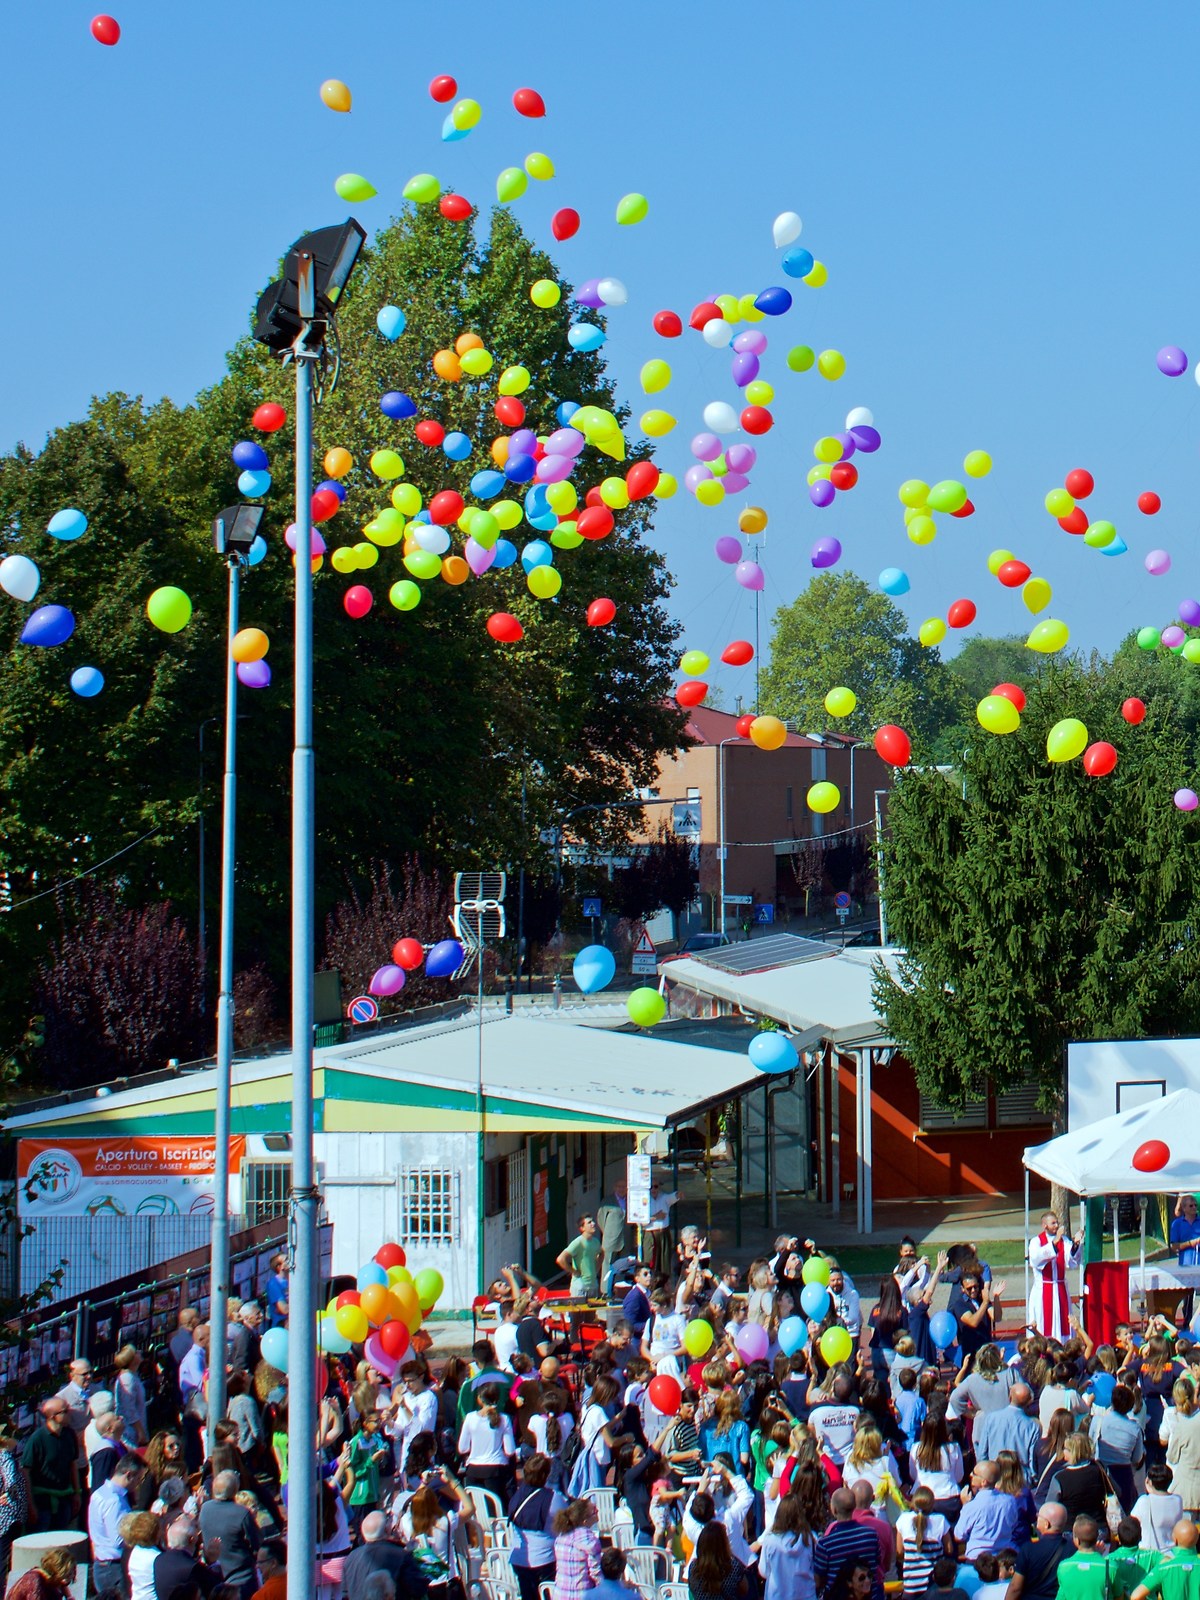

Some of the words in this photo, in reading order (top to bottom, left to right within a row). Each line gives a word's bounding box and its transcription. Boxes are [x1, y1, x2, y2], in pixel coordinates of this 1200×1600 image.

[95, 1147, 158, 1163] Apertura
[95, 1162, 121, 1171] CALCIO
[159, 1162, 183, 1170] BASKET
